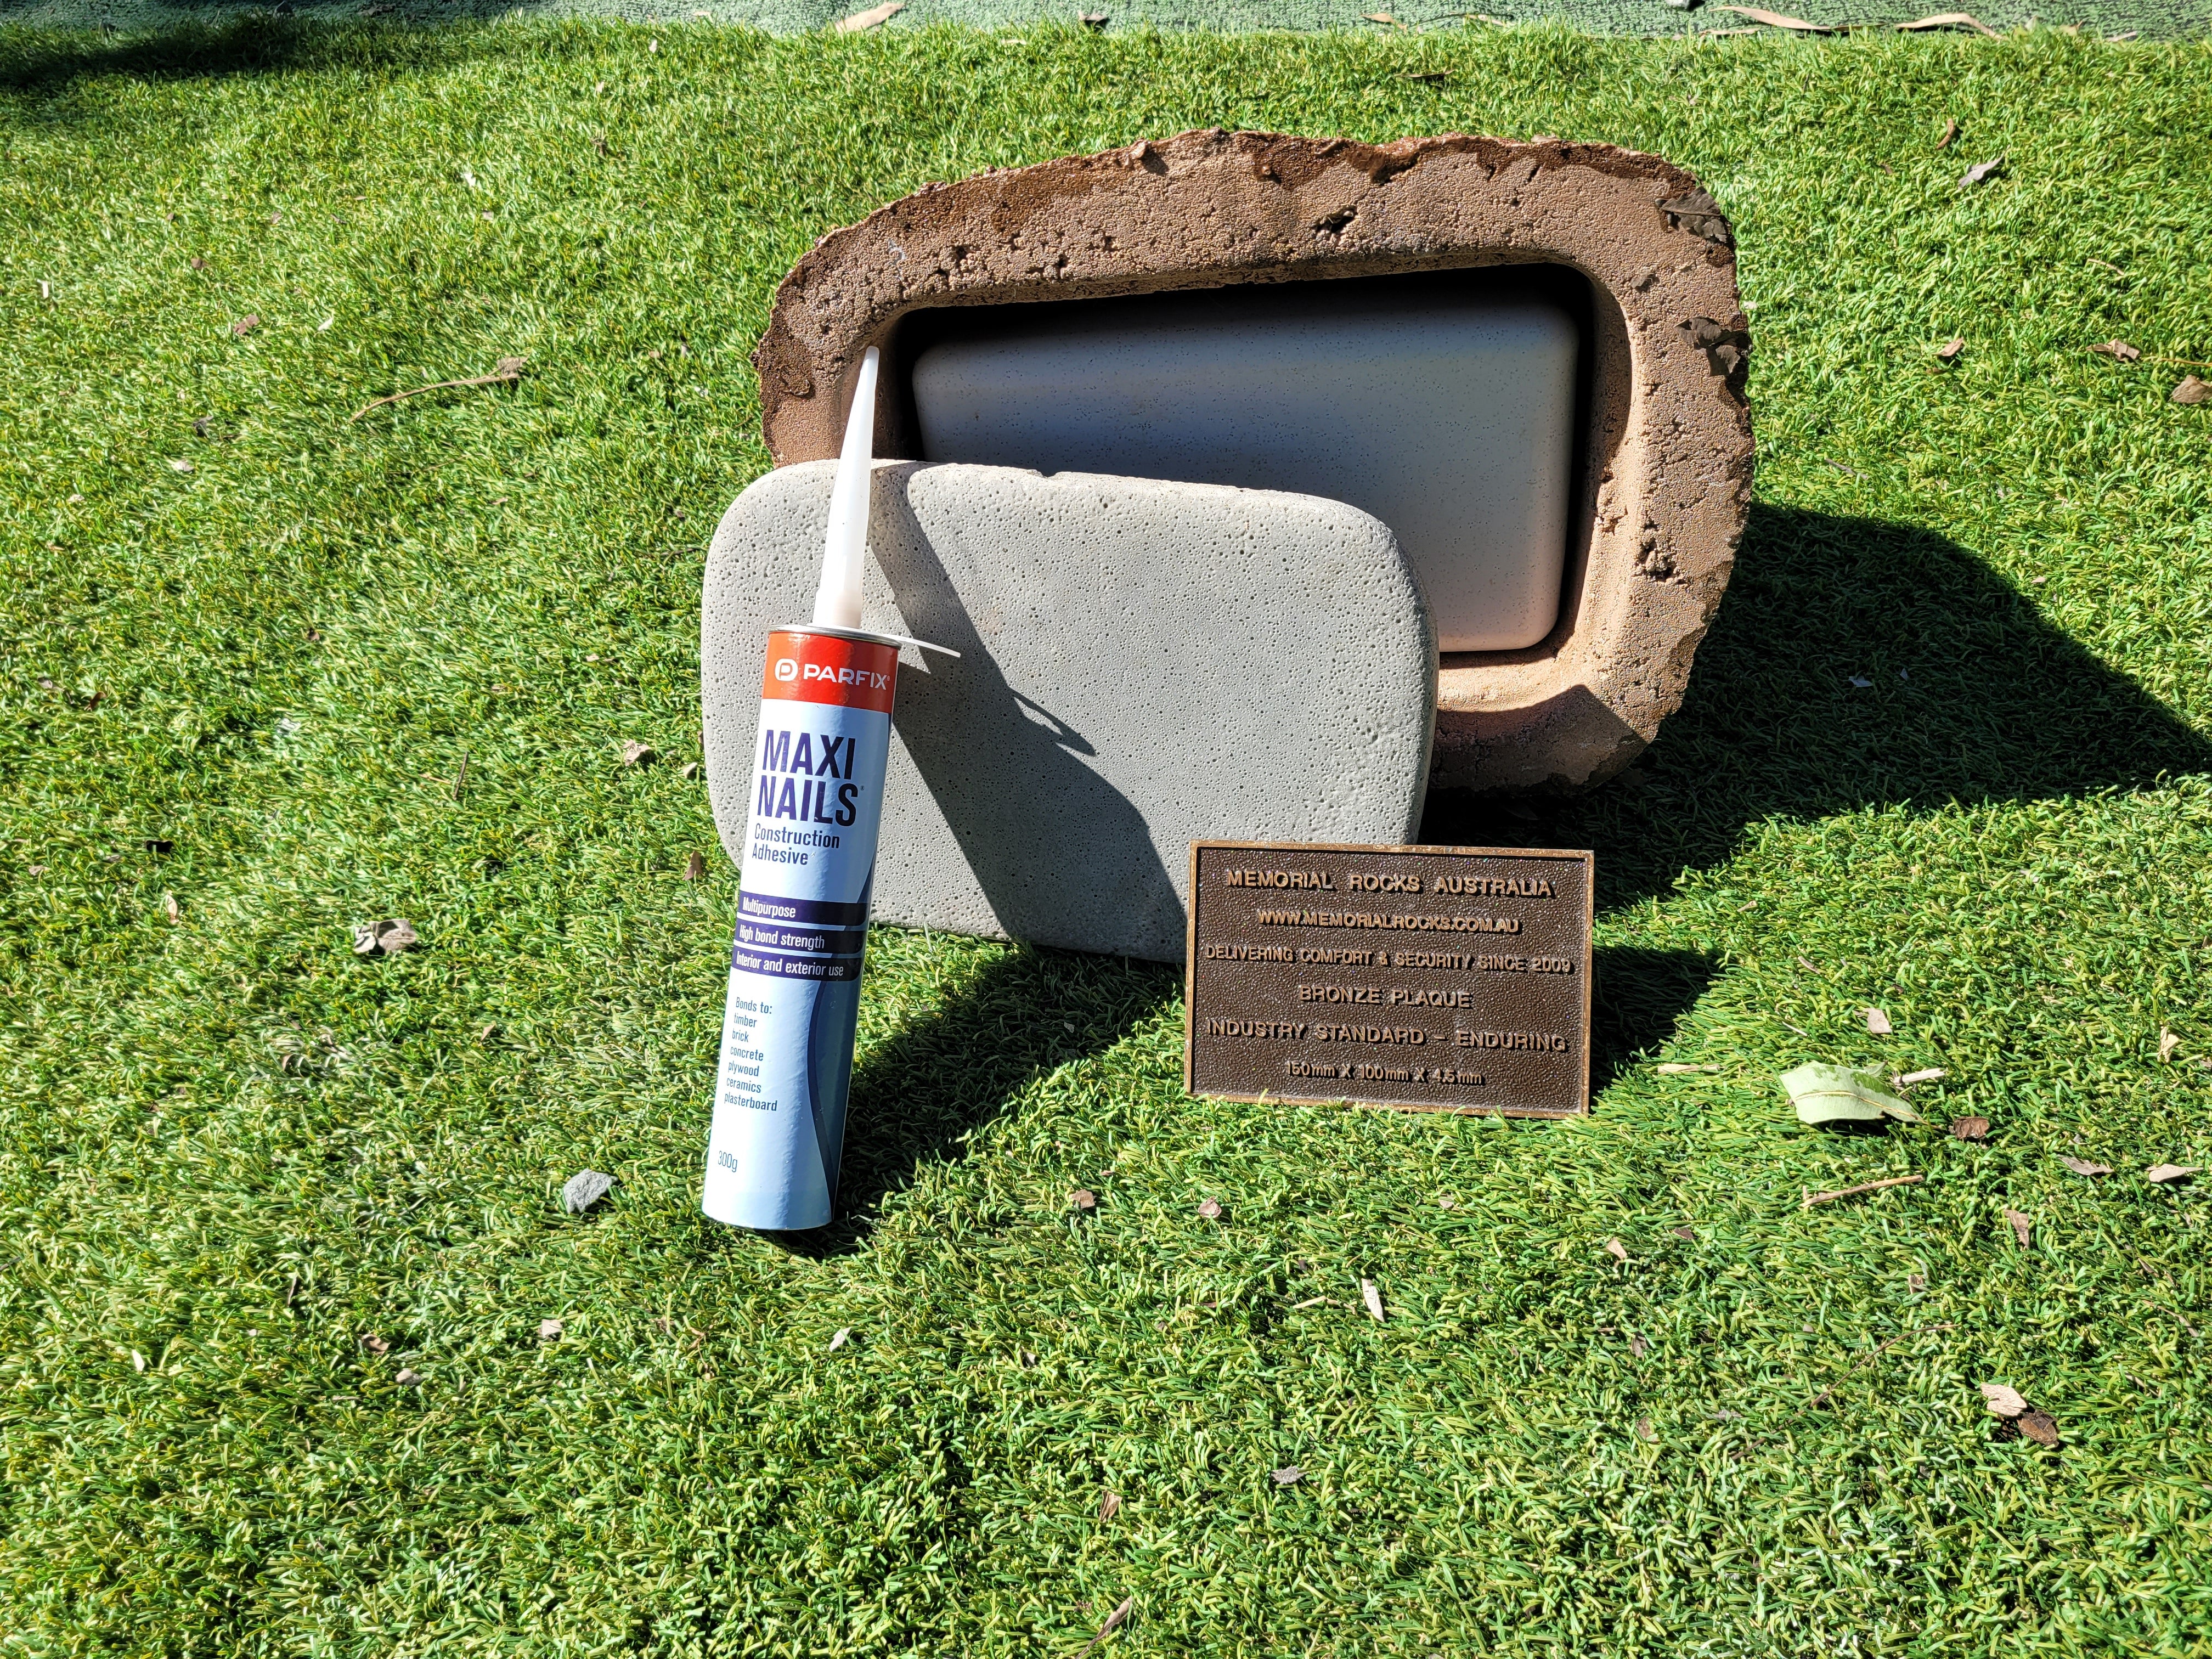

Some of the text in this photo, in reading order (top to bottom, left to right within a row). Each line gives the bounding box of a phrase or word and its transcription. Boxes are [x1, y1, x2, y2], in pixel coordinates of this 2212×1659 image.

[803, 663, 888, 691] PARFIX
[762, 729, 856, 780] MAXI
[757, 775, 859, 827] NAILS
[754, 823, 840, 849] Construction
[752, 843, 809, 866] Adhesive
[1227, 870, 1552, 896] MEMORIAL ROCKS AUSTRALIA
[742, 896, 796, 919] Multipurpose
[1258, 910, 1519, 933] WWW.MEMORIALROCKS.COM.AU
[739, 924, 825, 951] High bond strength
[736, 950, 844, 977] Interior and exterior use
[1206, 945, 1571, 973] DELIVERING COMFORT & SECURITY SINCE 2009
[736, 996, 772, 1014] Bonds to:
[1300, 985, 1471, 1008] BRONZE PLAQUE
[733, 1012, 758, 1028] timber
[732, 1028, 749, 1043] brick
[1207, 1019, 1306, 1038] INDUSTRY
[1316, 1024, 1424, 1045] STANDARD
[1457, 1030, 1566, 1051] ENDURING
[730, 1046, 764, 1062] concrete
[727, 1060, 760, 1077] plywood
[1288, 1062, 1482, 1085] 150mm X 100mm X 4.5mm
[726, 1076, 761, 1093] ceramics
[724, 1091, 778, 1111] plasterboard
[718, 1150, 738, 1173] 300g
